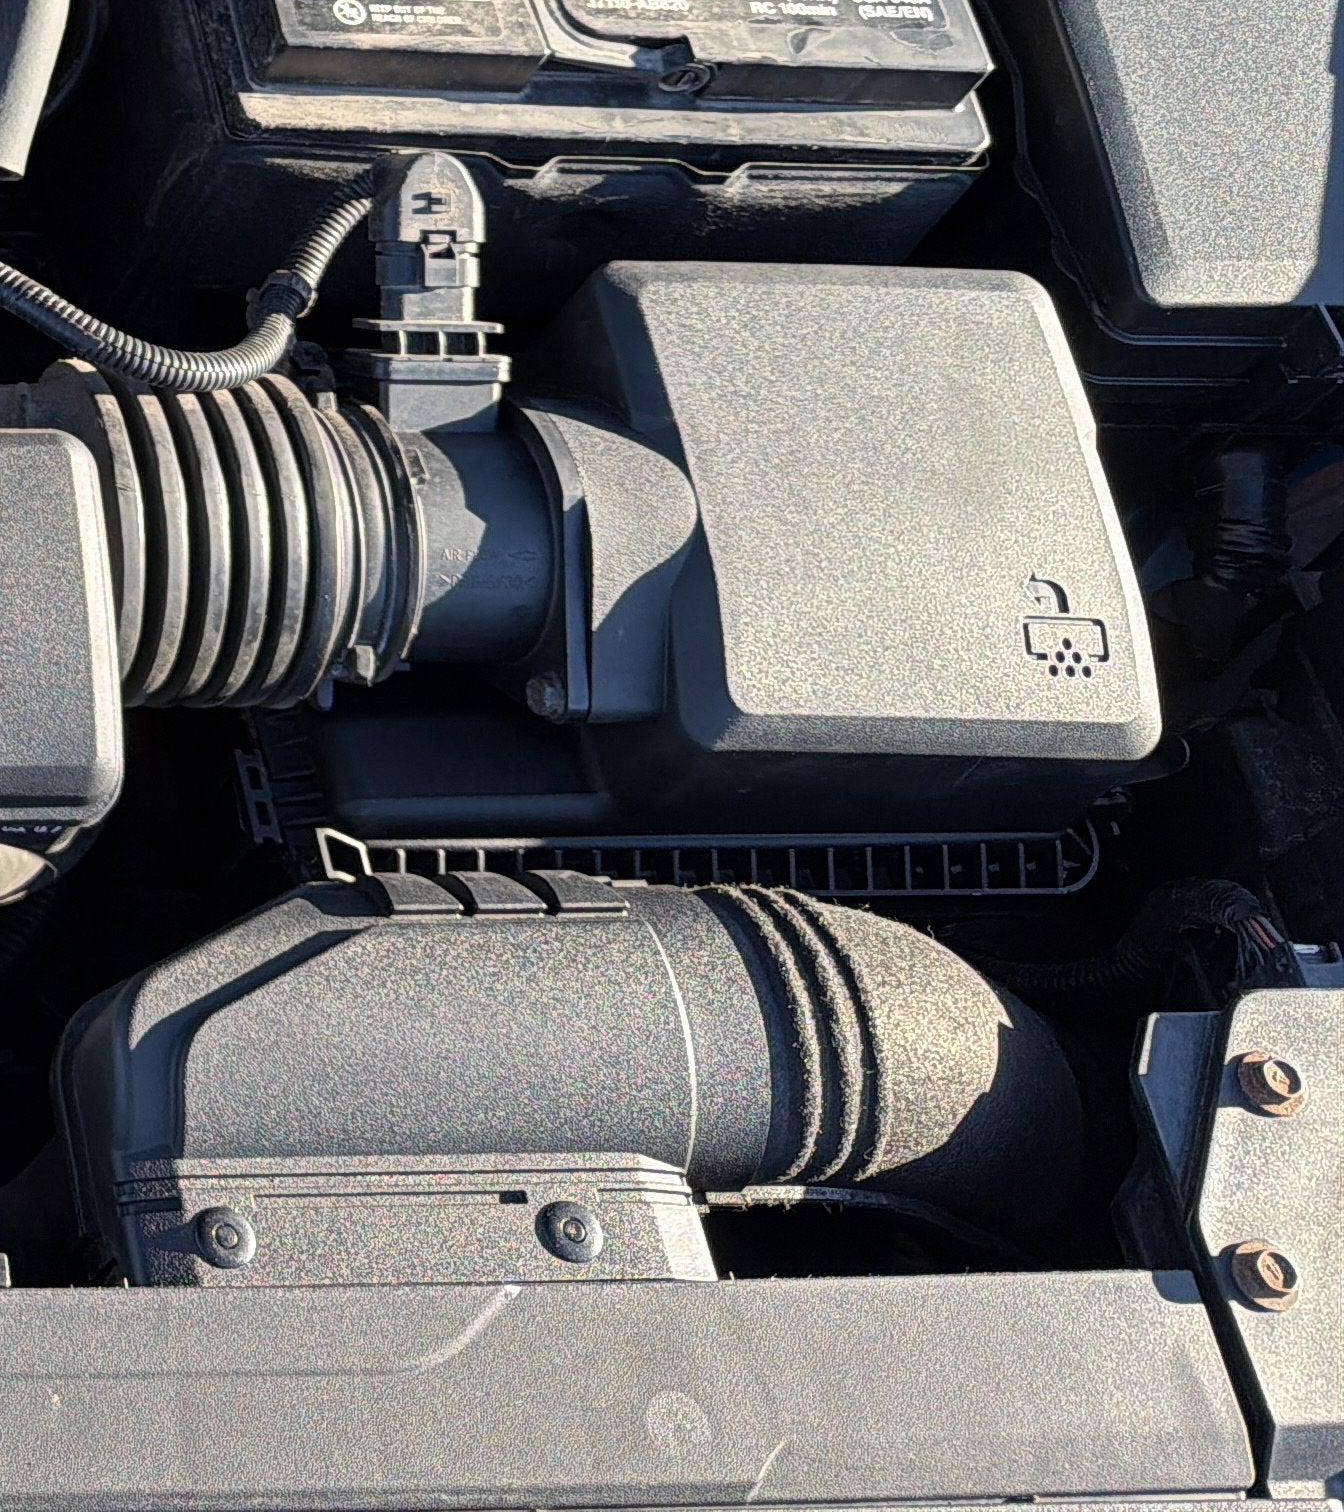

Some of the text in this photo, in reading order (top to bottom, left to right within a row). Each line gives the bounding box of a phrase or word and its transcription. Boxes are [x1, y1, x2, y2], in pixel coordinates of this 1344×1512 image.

[750, 2, 837, 16] RC 100min
[859, 5, 933, 21] (SAE/EN)
